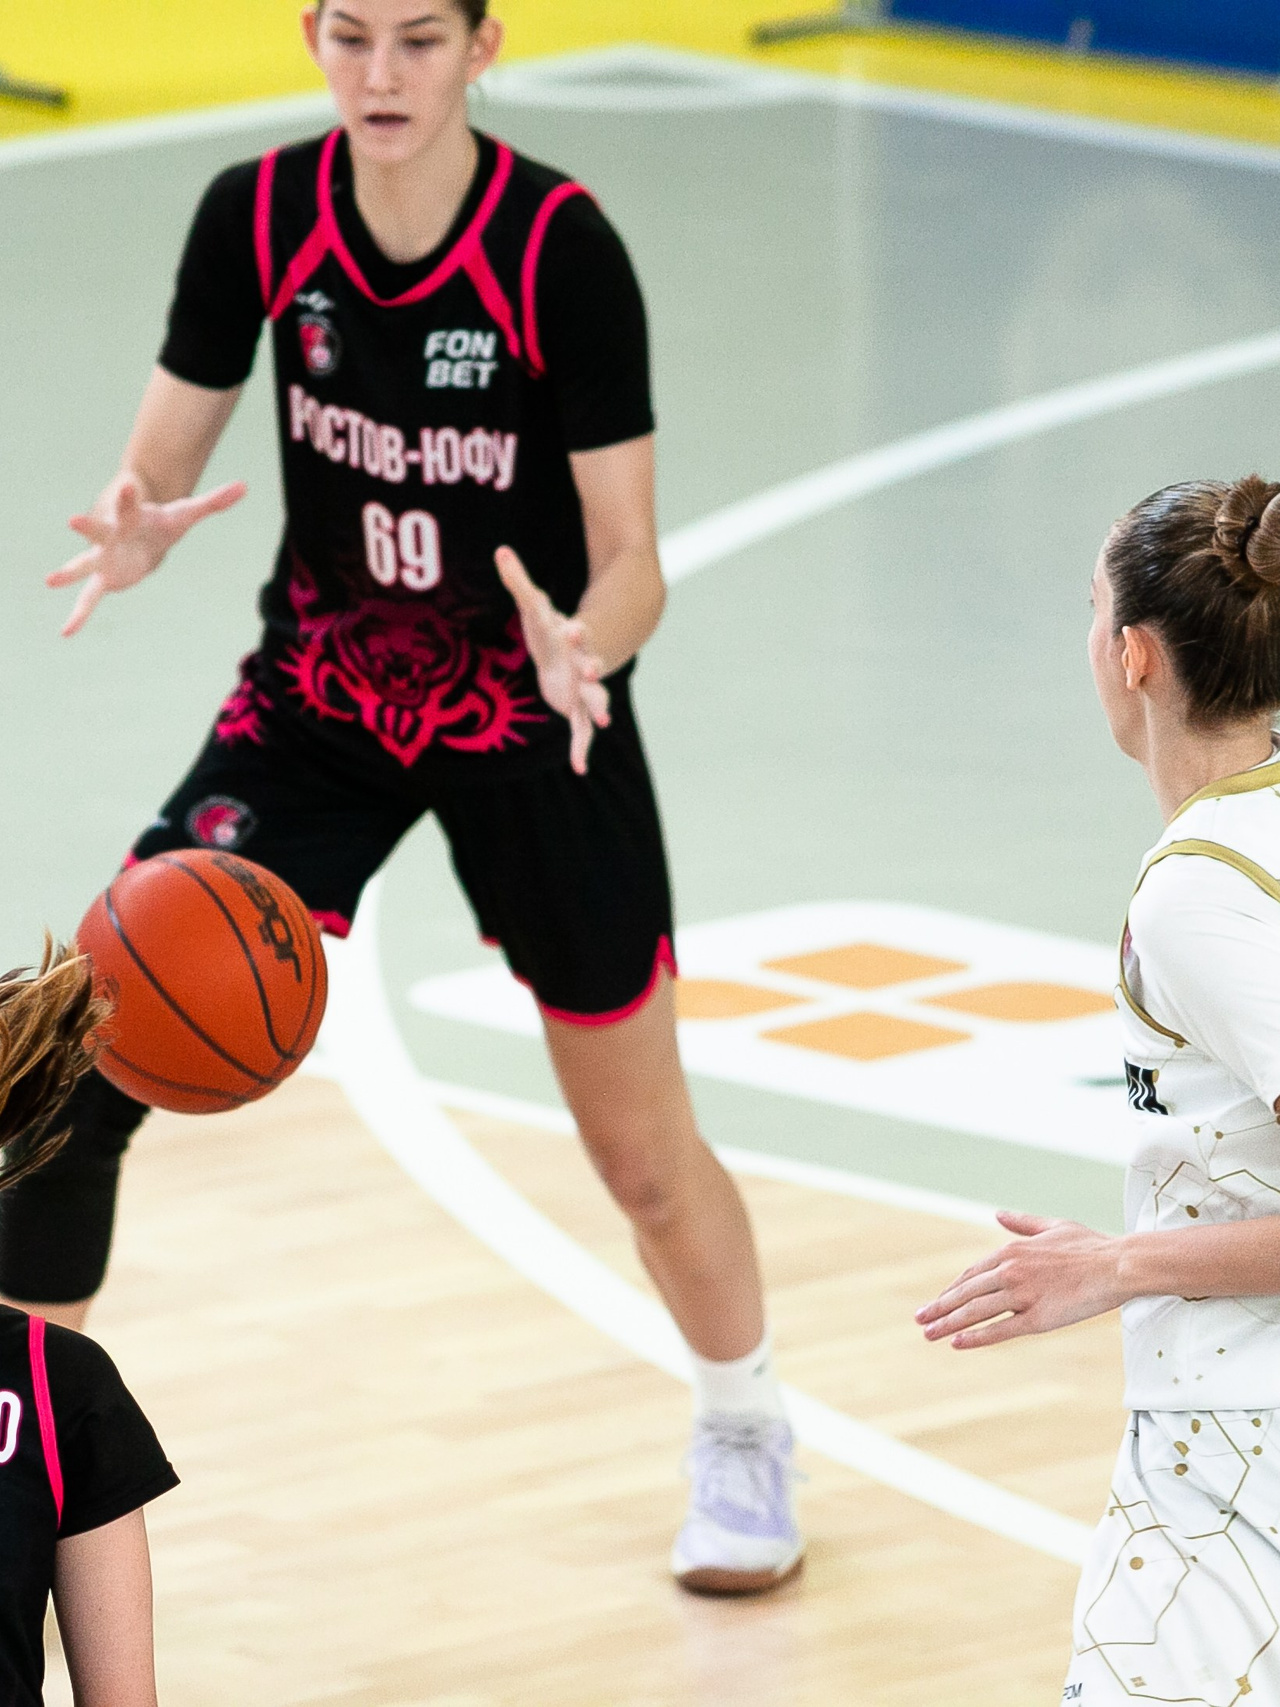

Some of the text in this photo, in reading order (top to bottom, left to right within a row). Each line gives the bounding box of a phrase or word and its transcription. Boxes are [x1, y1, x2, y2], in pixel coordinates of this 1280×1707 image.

[423, 328, 497, 360] FON
[425, 359, 499, 389] BET
[361, 500, 443, 592] 69
